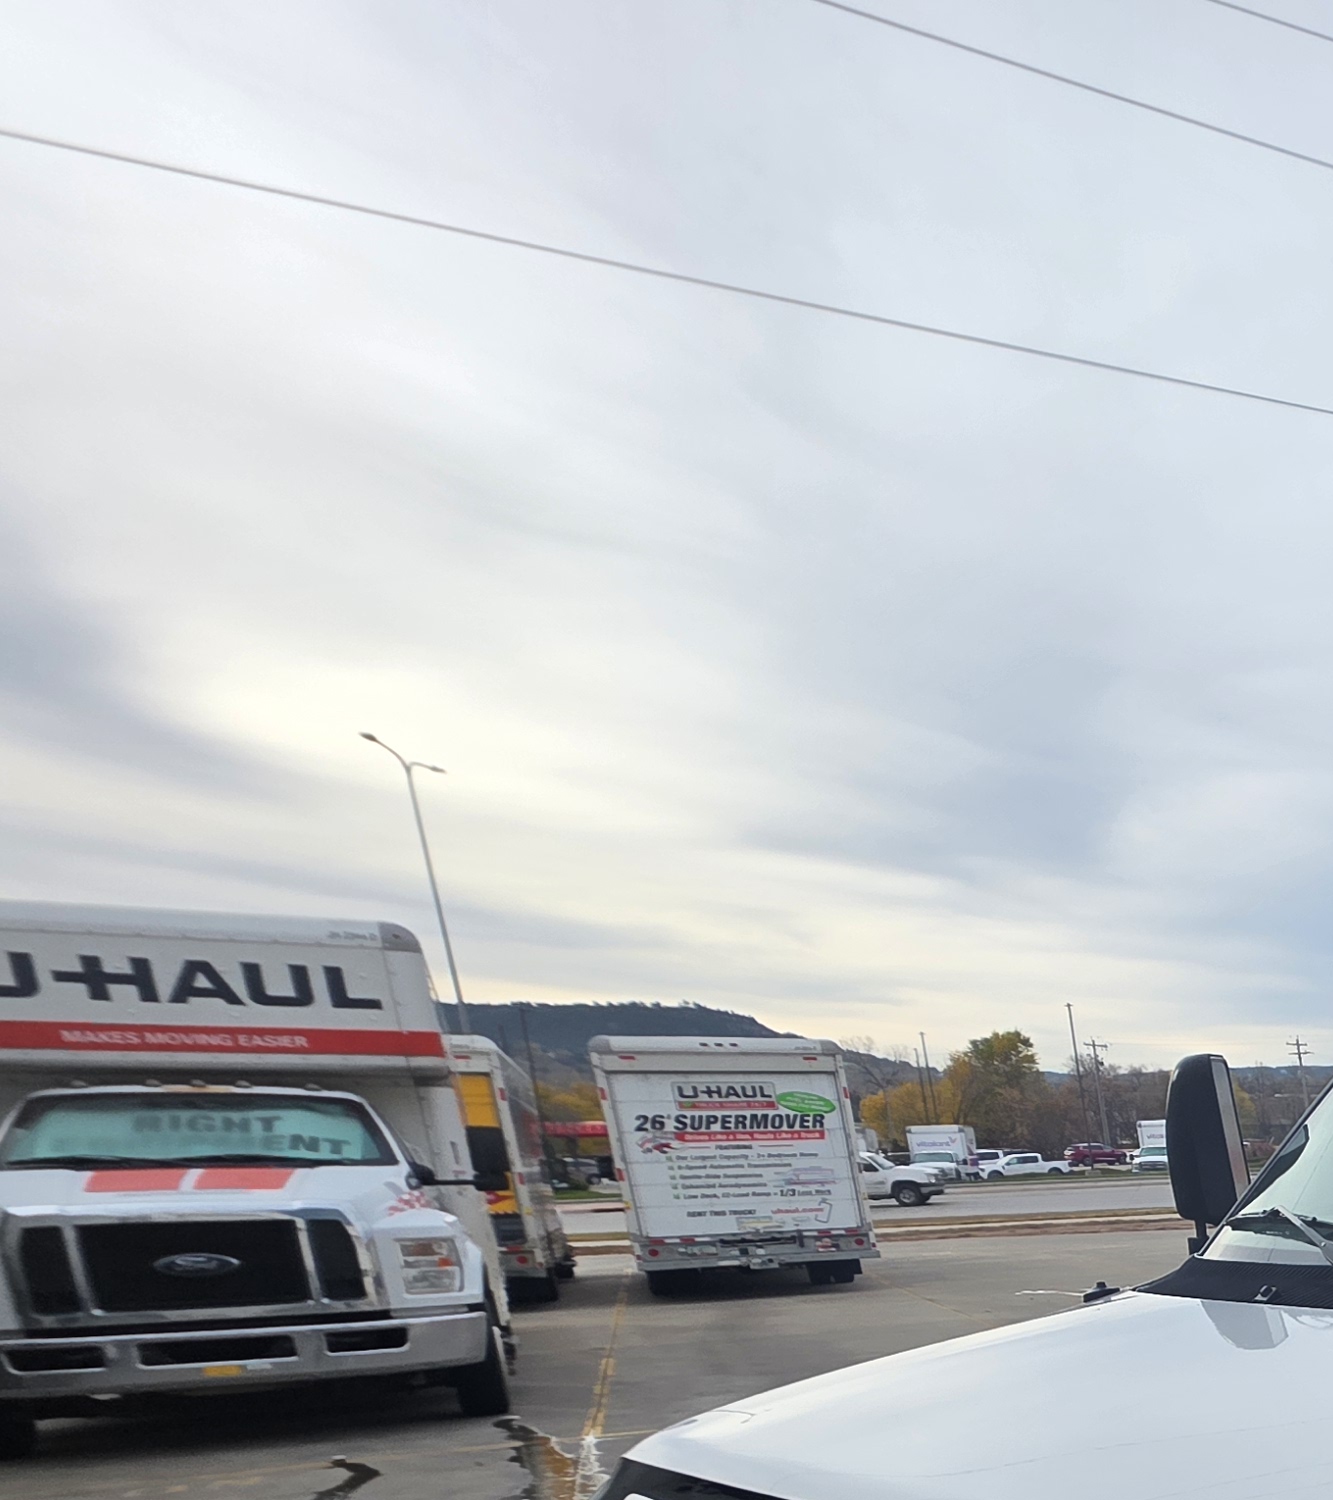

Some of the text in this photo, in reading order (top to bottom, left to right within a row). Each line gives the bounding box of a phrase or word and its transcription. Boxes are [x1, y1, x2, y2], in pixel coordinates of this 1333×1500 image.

[60, 1029, 308, 1049] MAKES MOVING EASIER
[676, 1085, 773, 1099] U-HAUL
[673, 1112, 826, 1131] SUPERMOVER
